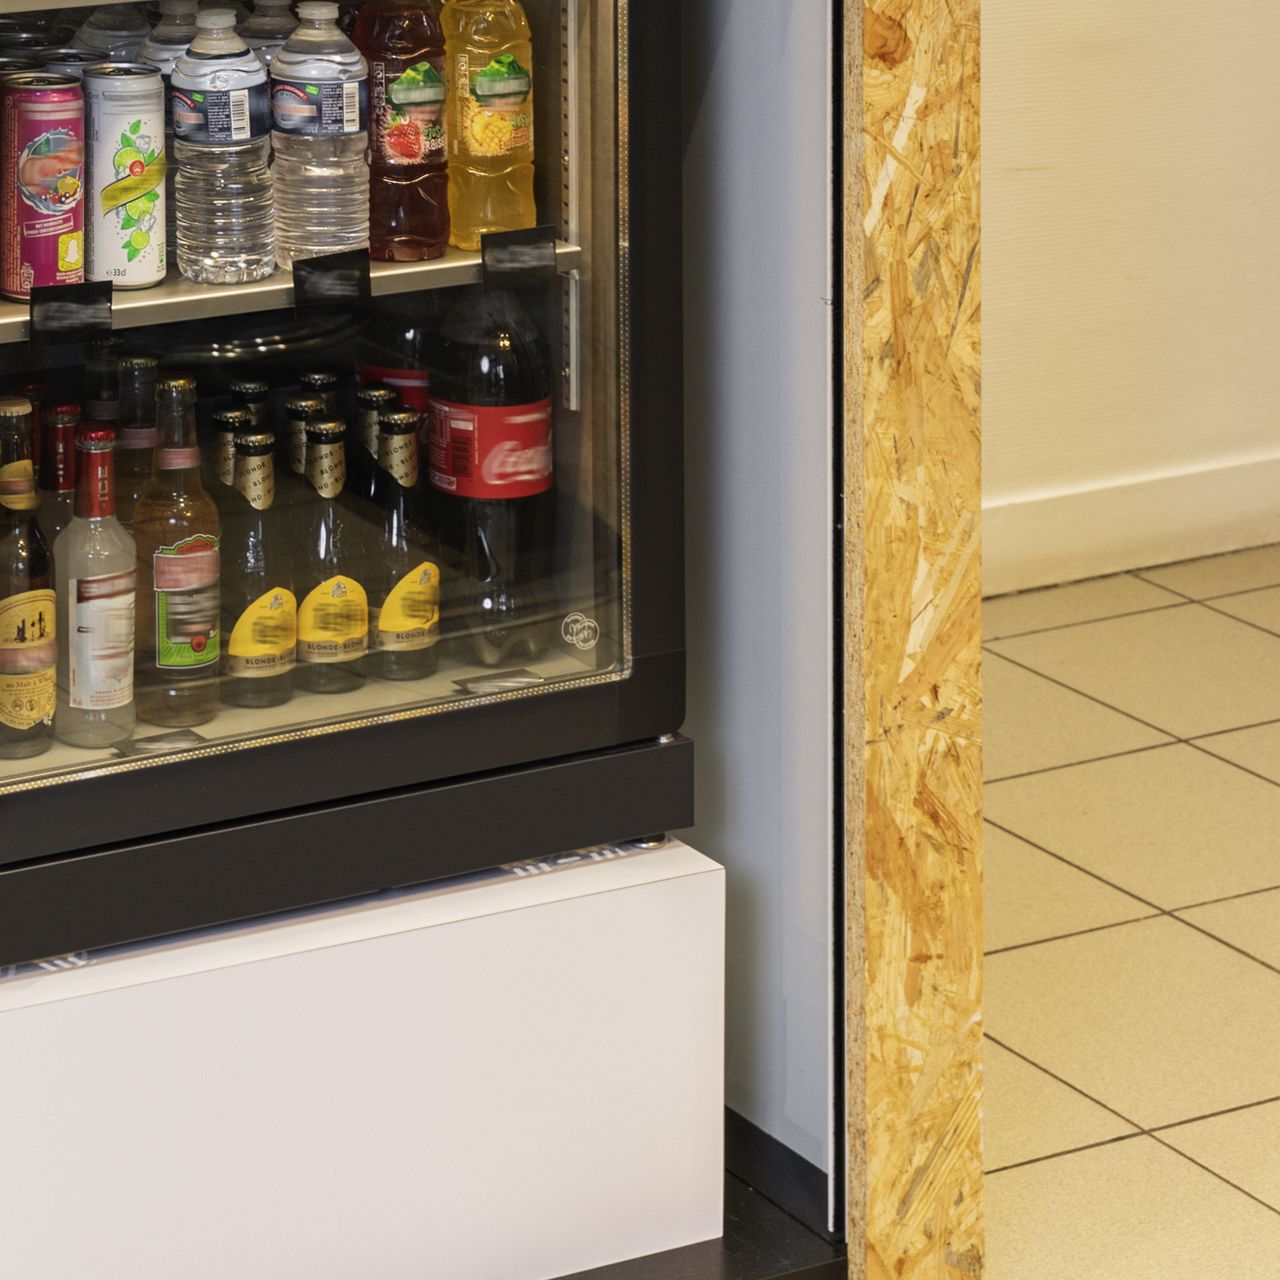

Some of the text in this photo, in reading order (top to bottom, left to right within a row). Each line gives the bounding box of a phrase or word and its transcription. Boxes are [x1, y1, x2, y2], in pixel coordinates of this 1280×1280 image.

[396, 630, 425, 640] BLONDE
[307, 642, 338, 651] BLONDE
[245, 656, 277, 666] BLONDE
